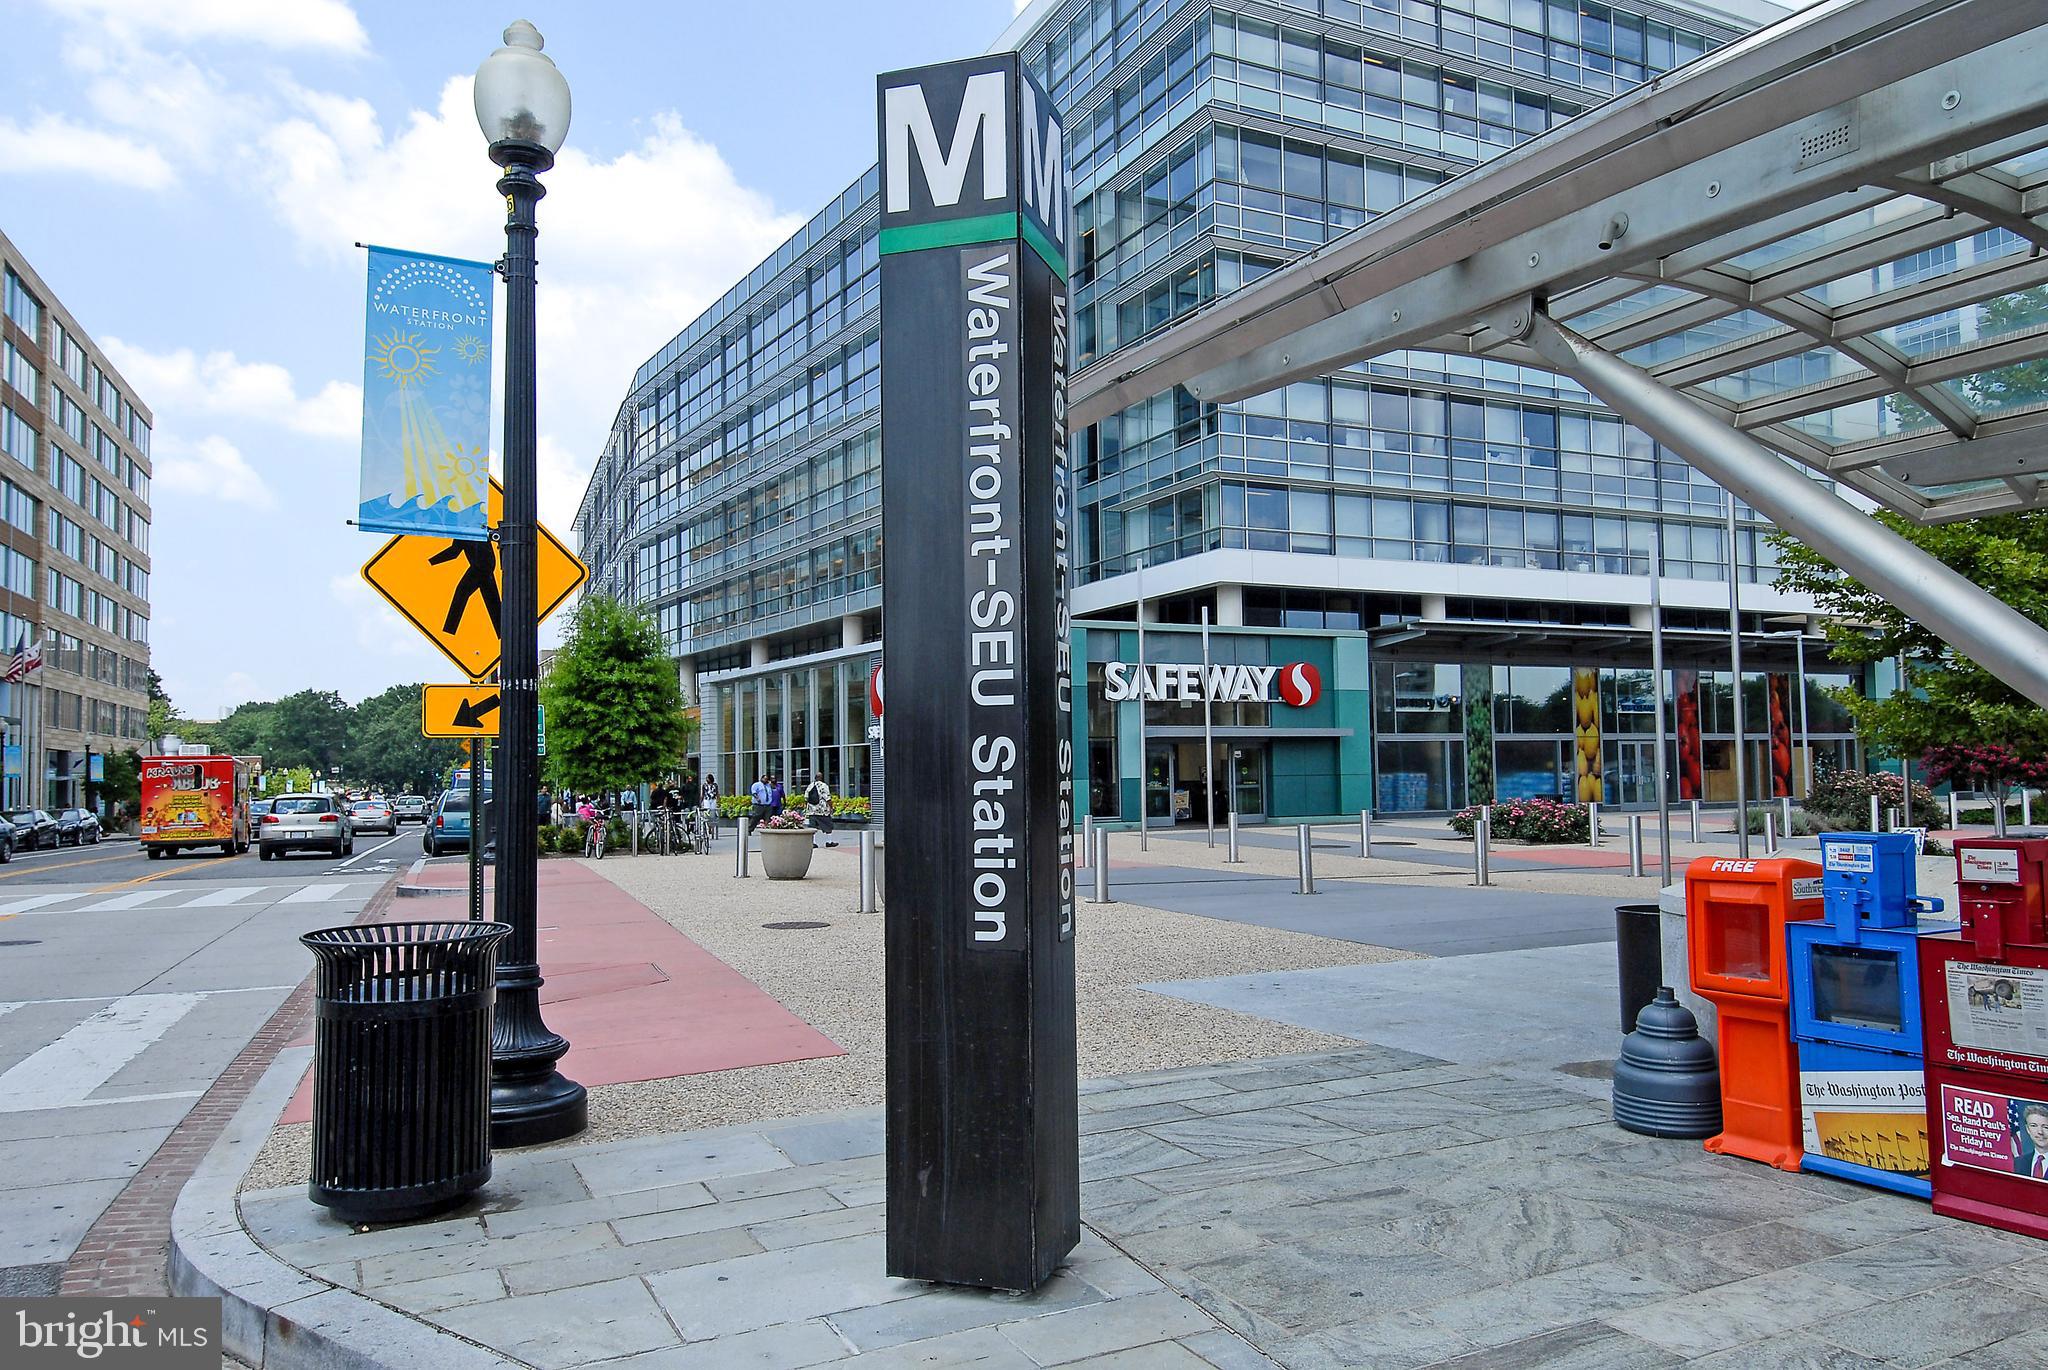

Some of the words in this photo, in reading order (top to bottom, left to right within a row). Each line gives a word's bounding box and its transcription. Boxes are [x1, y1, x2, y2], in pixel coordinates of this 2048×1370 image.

[885, 70, 1007, 214] M
[1022, 75, 1064, 245] M
[373, 302, 488, 327] WATERFRONT
[407, 318, 455, 331] STATION
[967, 253, 1016, 707] Waterfront-SEU
[1105, 661, 1278, 702] SAFEWAY
[971, 734, 1017, 943] Station
[1057, 738, 1074, 934] Station
[1711, 860, 1758, 873] FREE
[1956, 962, 1970, 971] The
[1970, 963, 2011, 975] Washington
[2011, 966, 2034, 976] Times
[1947, 1048, 1966, 1063] The
[1966, 1052, 2028, 1071] Washington
[1805, 1083, 1825, 1098] The
[1827, 1081, 1896, 1100] Washington
[1954, 1097, 1994, 1119] READ
[1946, 1112, 1962, 1123] Sen.
[1962, 1115, 1981, 1127] Rand
[1982, 1118, 2007, 1131] Paul's
[1951, 1123, 1979, 1135] Column
[1979, 1129, 2001, 1142] Every
[1960, 1134, 1983, 1149] Friday
